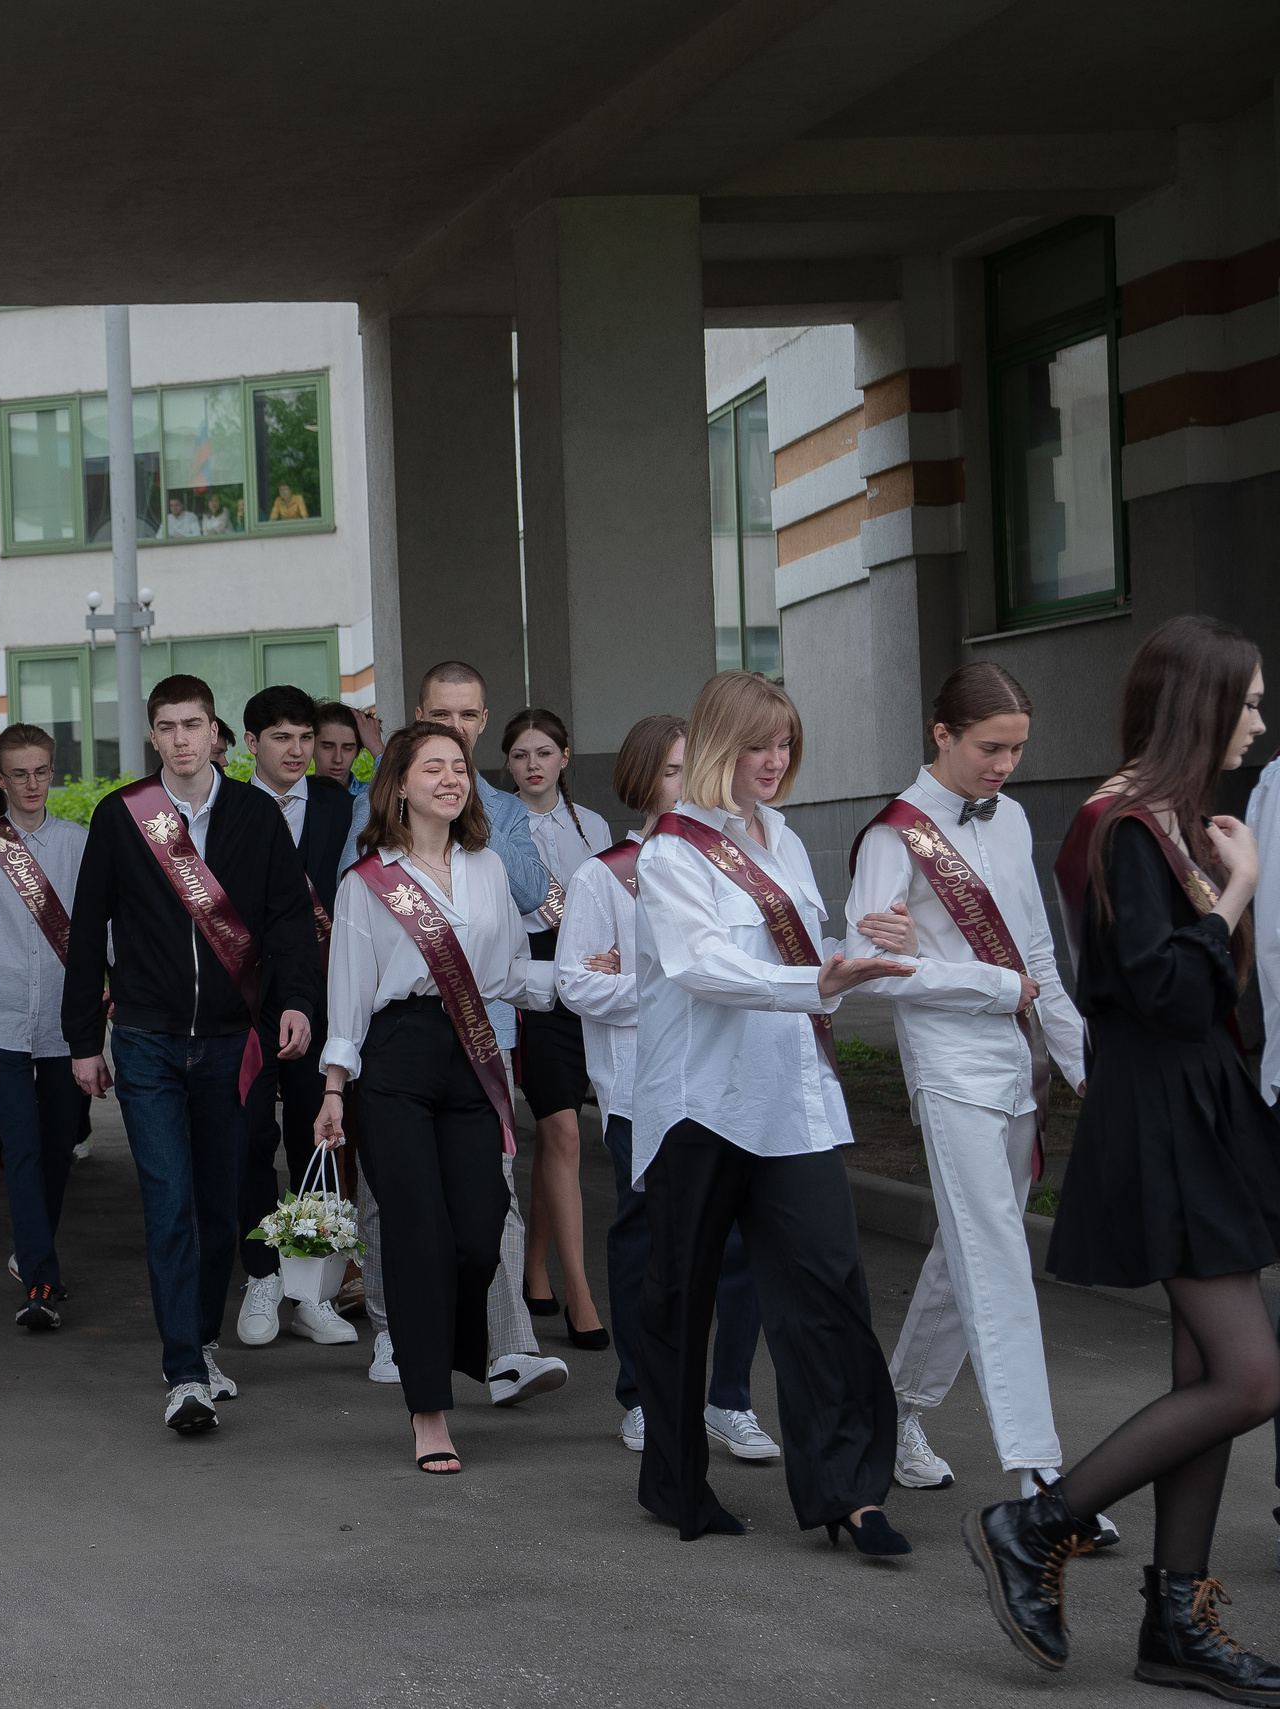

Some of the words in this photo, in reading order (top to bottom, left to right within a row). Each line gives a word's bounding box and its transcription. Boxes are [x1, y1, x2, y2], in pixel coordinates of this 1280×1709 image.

[167, 843, 235, 941] Выпускник
[745, 868, 809, 968] Выпускни
[417, 915, 477, 1027] Выпускница
[468, 1020, 500, 1064] 2023
